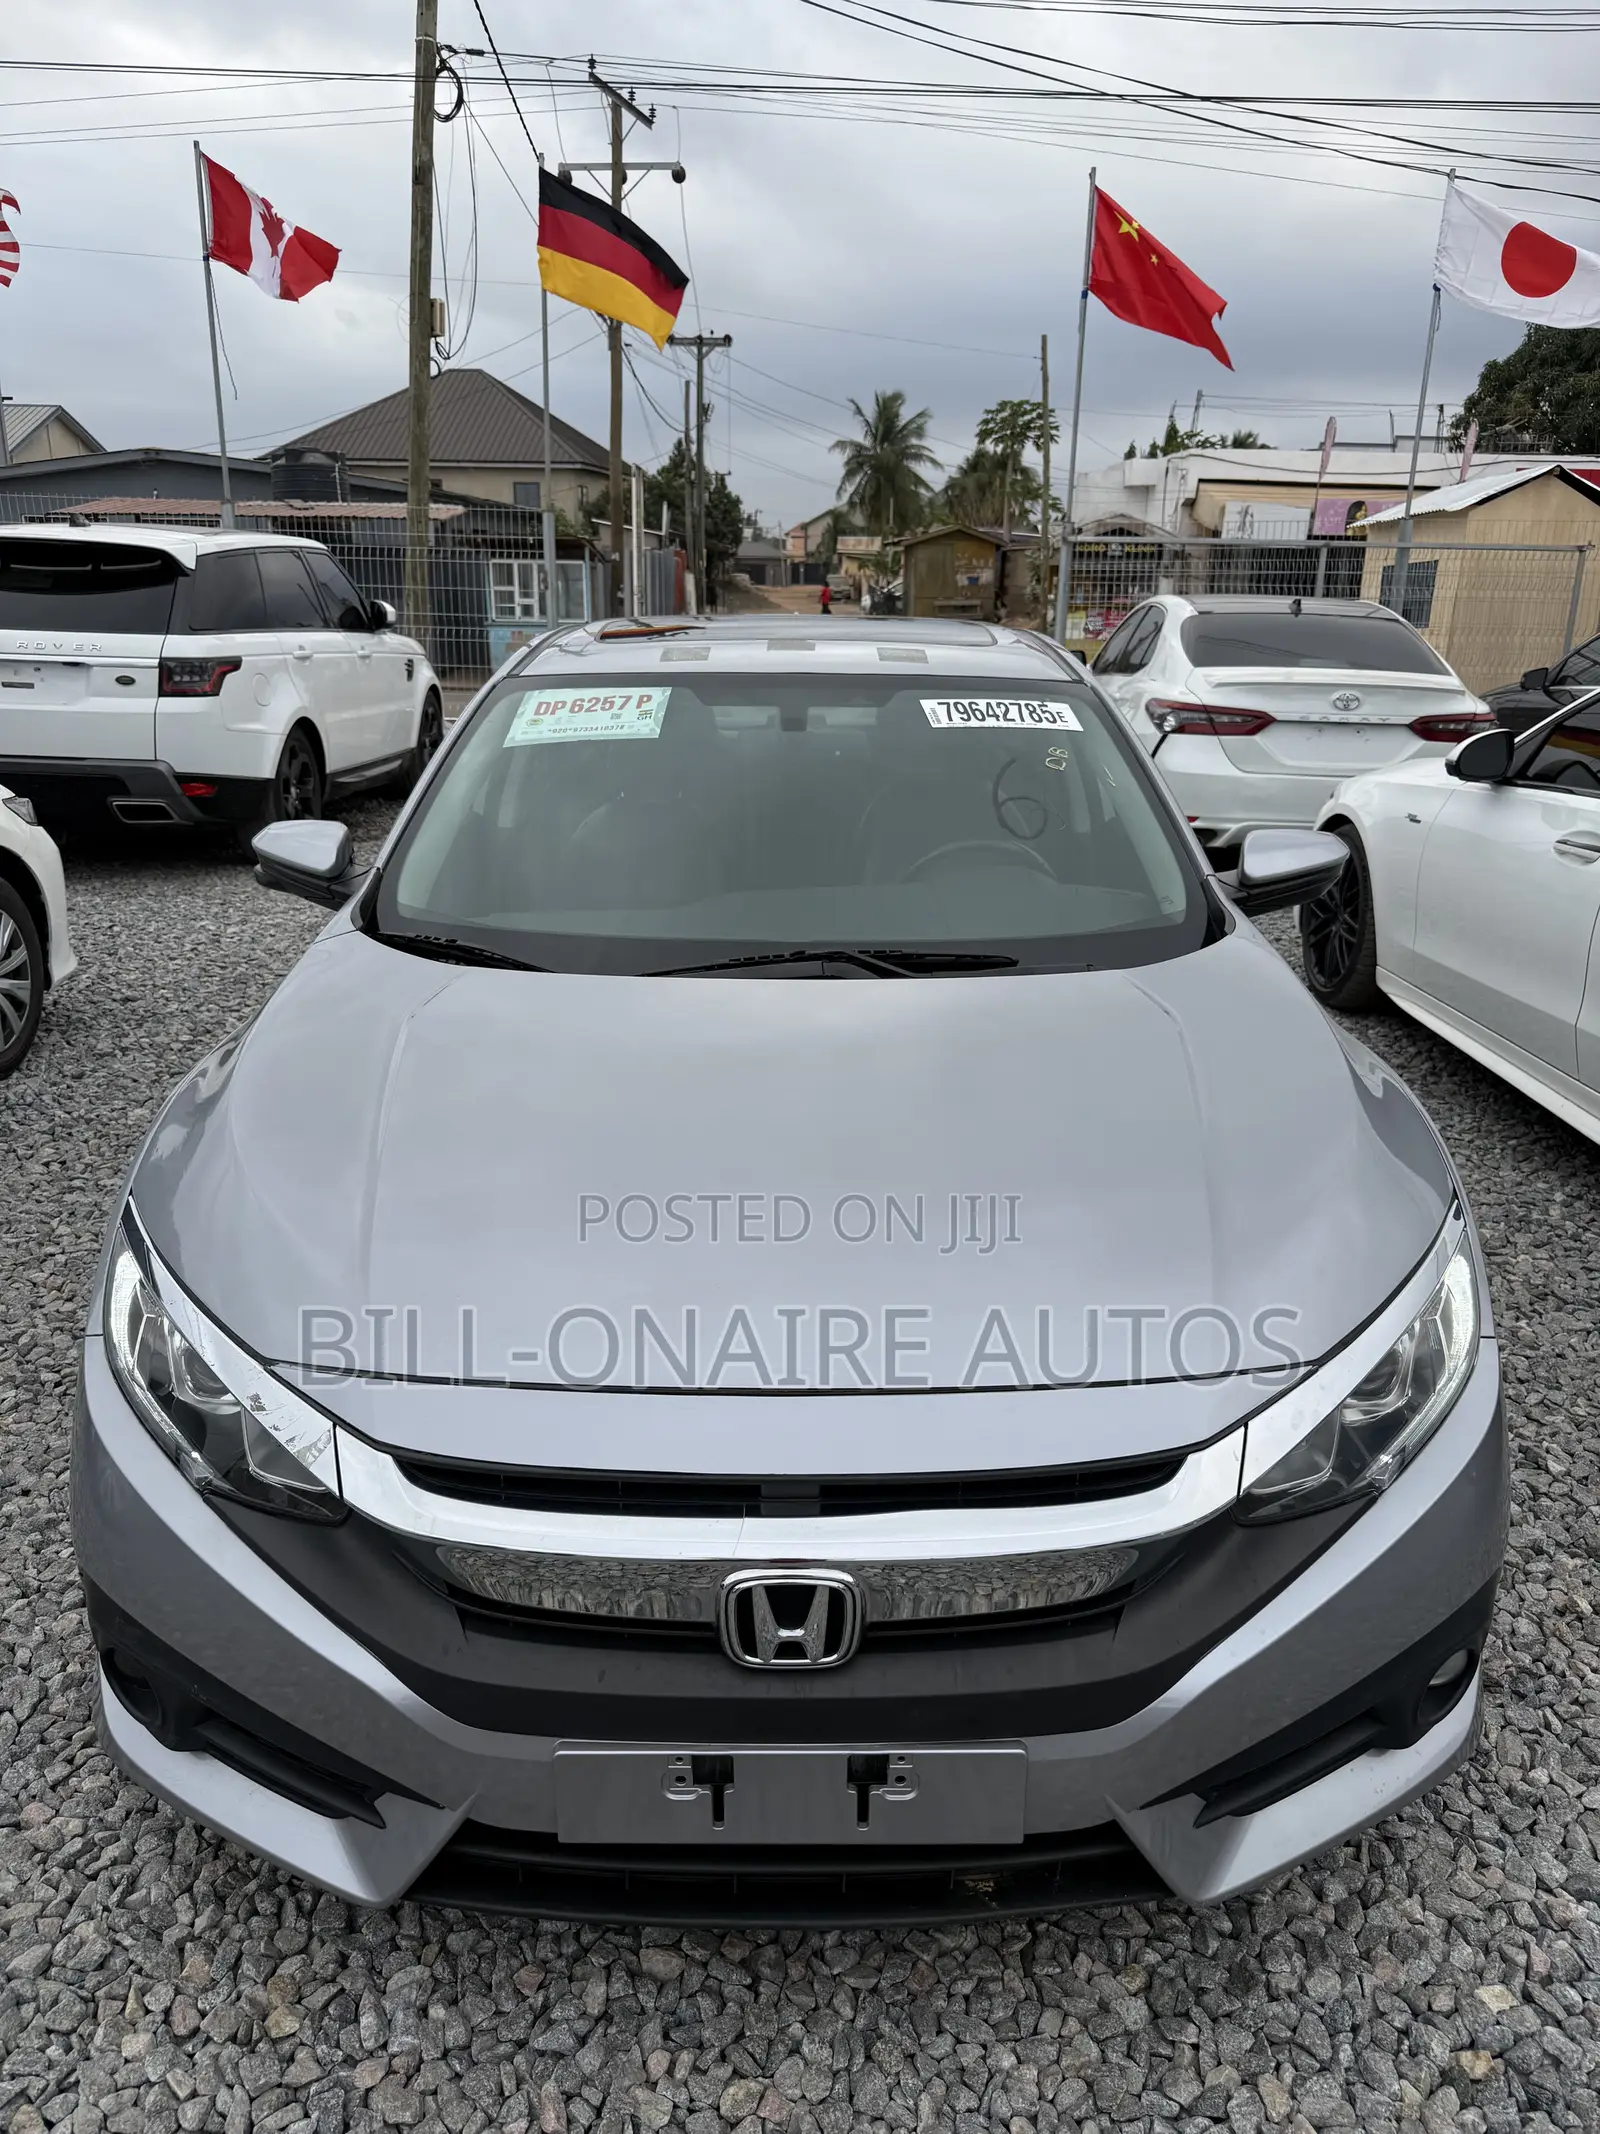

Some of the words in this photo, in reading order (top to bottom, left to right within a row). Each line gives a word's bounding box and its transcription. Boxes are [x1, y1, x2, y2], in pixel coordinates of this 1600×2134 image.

[16, 641, 102, 652] ROVER
[534, 701, 567, 716] DP
[569, 695, 633, 714] 6257
[636, 694, 653, 709] P
[937, 701, 1057, 724] 79642785
[1056, 711, 1068, 723] E
